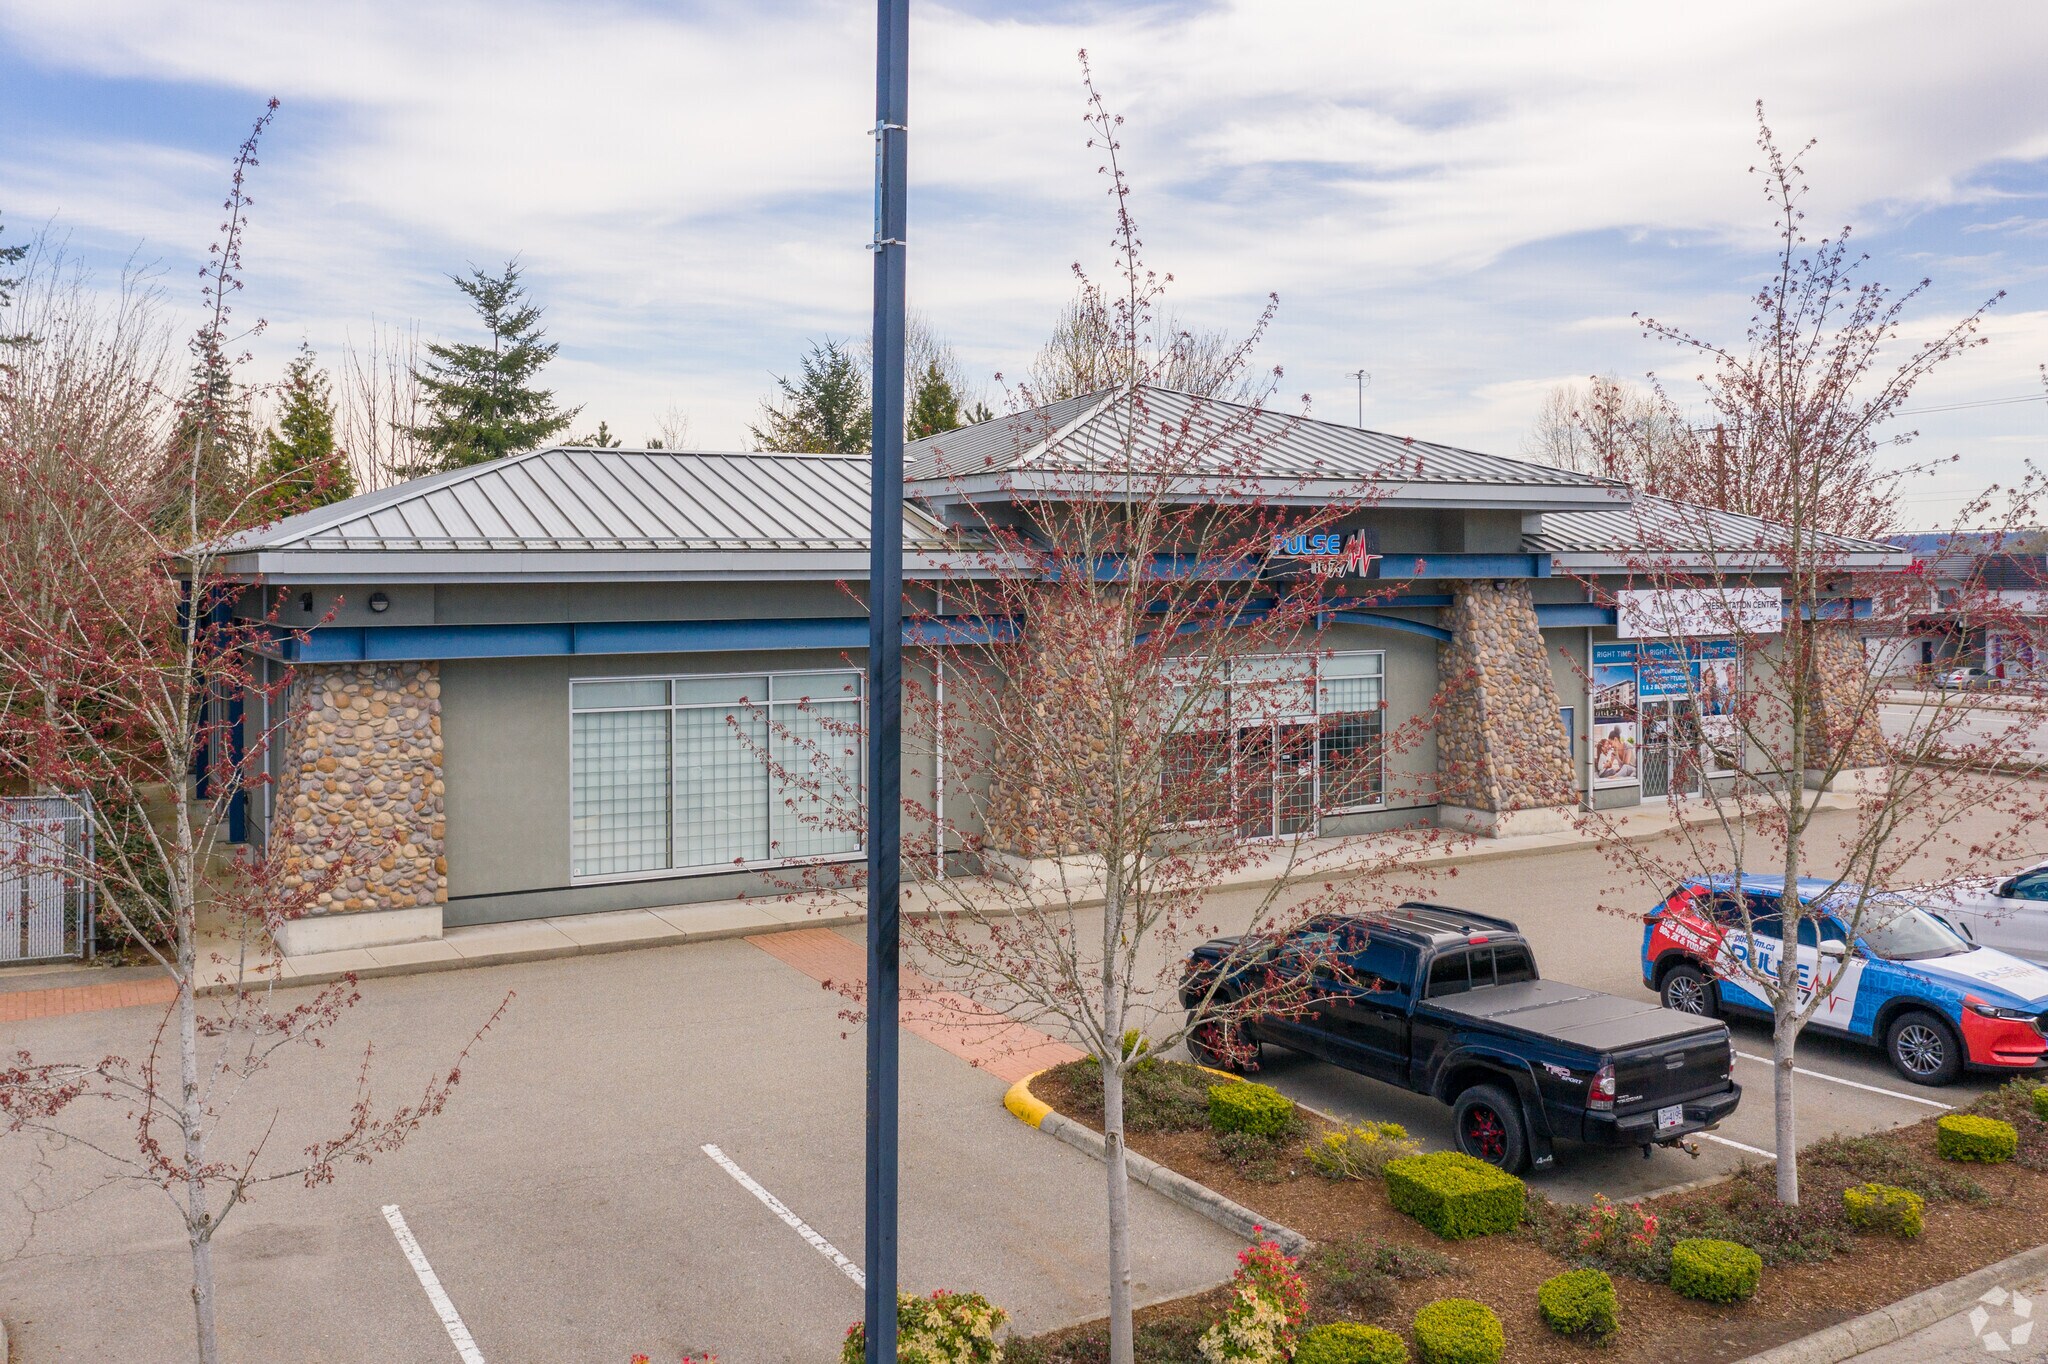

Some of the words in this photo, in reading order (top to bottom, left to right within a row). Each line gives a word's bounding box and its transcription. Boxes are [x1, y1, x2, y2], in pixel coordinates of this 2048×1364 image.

[1274, 534, 1340, 554] PULSE
[1703, 601, 1751, 610] PRESETATON
[1753, 600, 1778, 609] CENTRE
[1617, 650, 1632, 658] TIME
[1650, 648, 1668, 656] RIGHT
[1661, 918, 1678, 931] THE
[1734, 934, 1776, 951] pulfm.ca
[1731, 943, 1809, 986] PULE
[1543, 1063, 1571, 1077] TRD
[1561, 1076, 1583, 1085] SPORT
